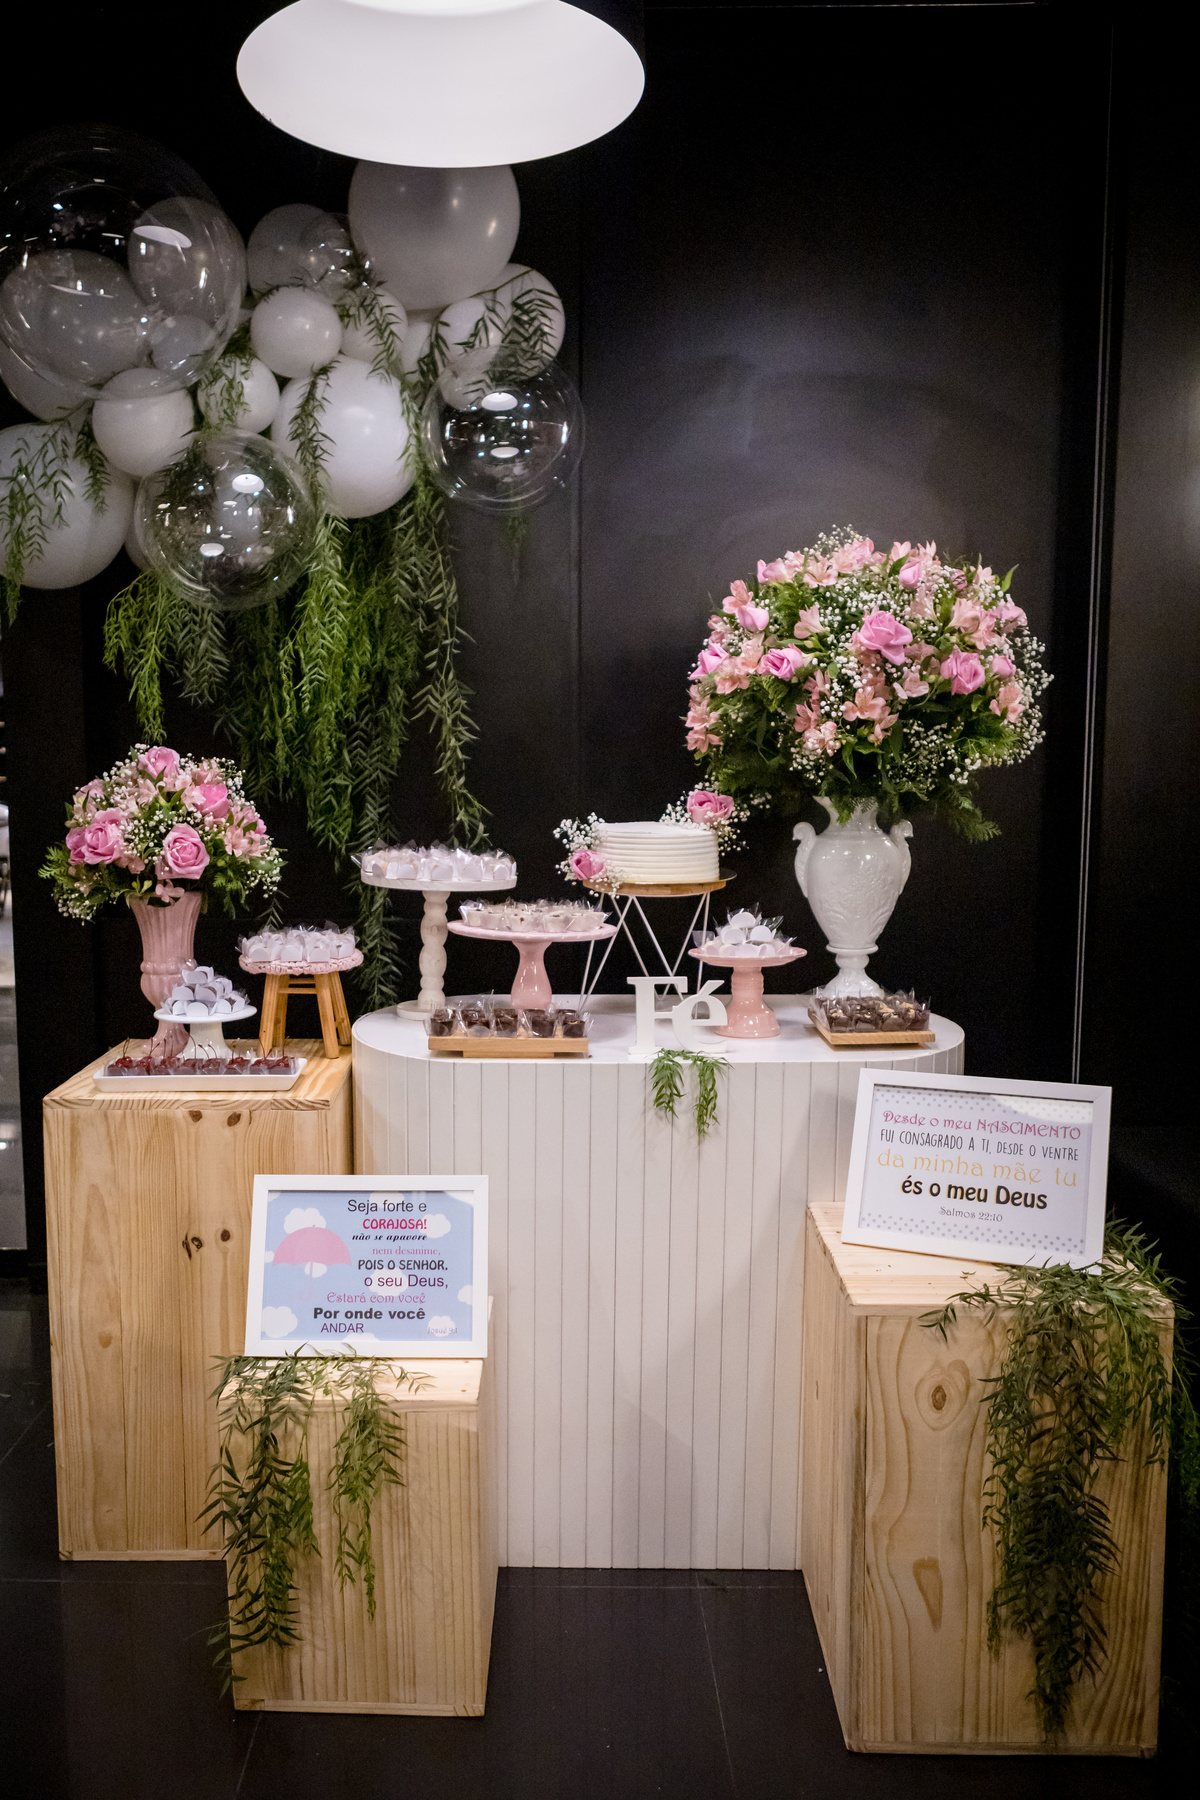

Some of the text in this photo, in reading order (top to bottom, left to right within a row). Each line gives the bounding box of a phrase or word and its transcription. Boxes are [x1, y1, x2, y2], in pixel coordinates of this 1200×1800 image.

[626, 975, 728, 1055] Fé
[882, 1110, 1081, 1140] Desde o meu NASCIMENTO
[880, 1128, 895, 1143] FUI
[899, 1130, 963, 1150] CONSAGRADO
[968, 1136, 975, 1151] A
[996, 1141, 1024, 1156] DESDE
[1029, 1144, 1037, 1157] O
[1042, 1145, 1079, 1161] VENTRE
[877, 1148, 1077, 1187] da minha mãe tu
[901, 1174, 1048, 1210] és o meu Deus
[347, 1199, 427, 1215] Seja forte e
[939, 1206, 1003, 1223] Salmos 22:10
[362, 1218, 428, 1230] CORAJOSA!
[351, 1232, 428, 1243] não se apavore
[372, 1245, 441, 1256] nem desanime,
[358, 1259, 384, 1271] POIS
[387, 1259, 396, 1271] O
[364, 1274, 449, 1289] o seu Deus,
[326, 1291, 426, 1305] Estará com você
[313, 1307, 426, 1320] Por onde você
[320, 1322, 365, 1333] ANDAR
